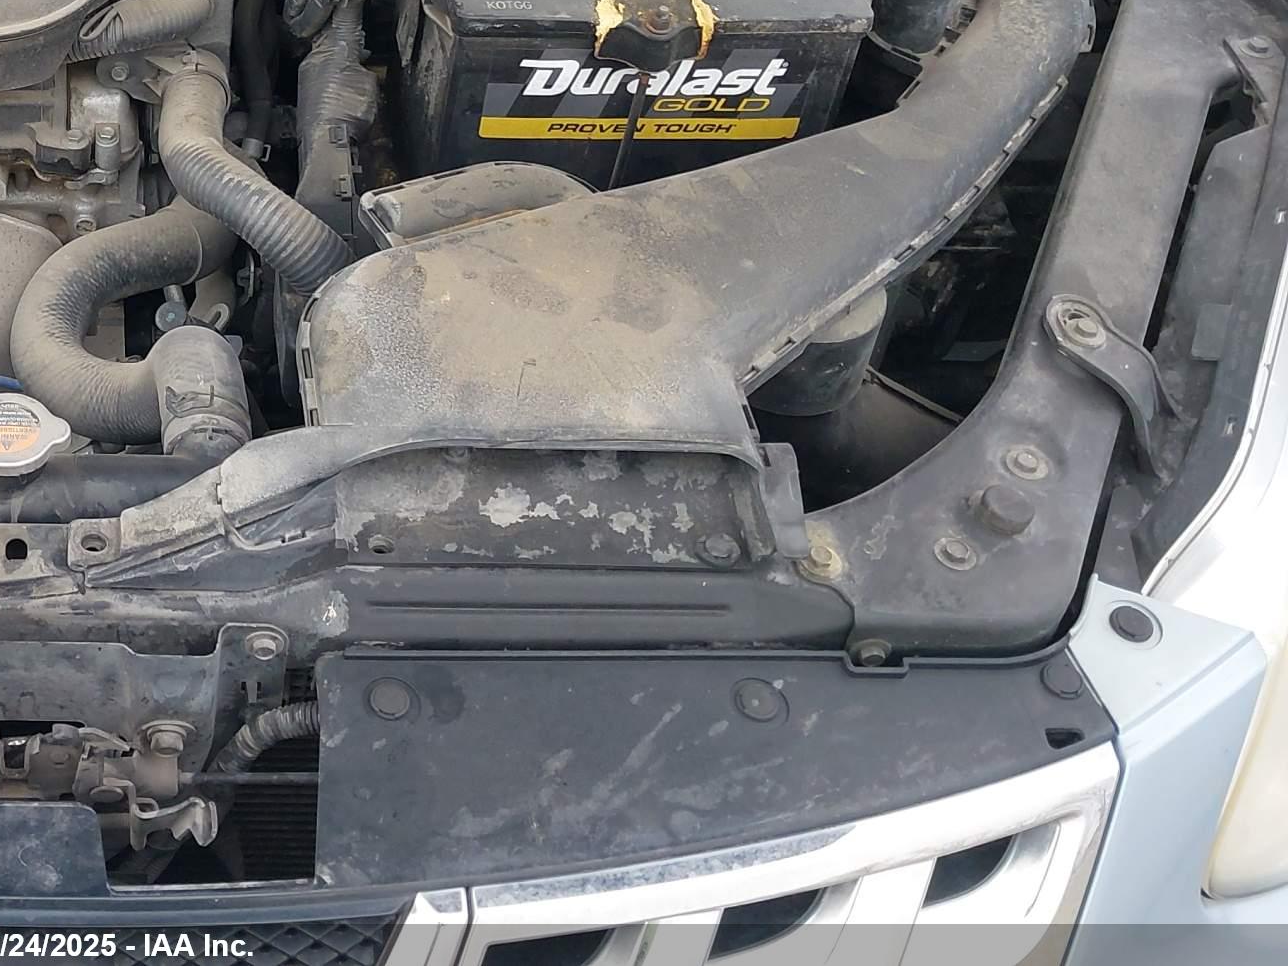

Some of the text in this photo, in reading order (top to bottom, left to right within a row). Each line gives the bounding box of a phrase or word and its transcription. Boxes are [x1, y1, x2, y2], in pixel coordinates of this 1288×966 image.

[520, 58, 786, 96] Duralast
[653, 97, 770, 113] GOLD
[547, 123, 733, 134] PROVEN TOUGH
